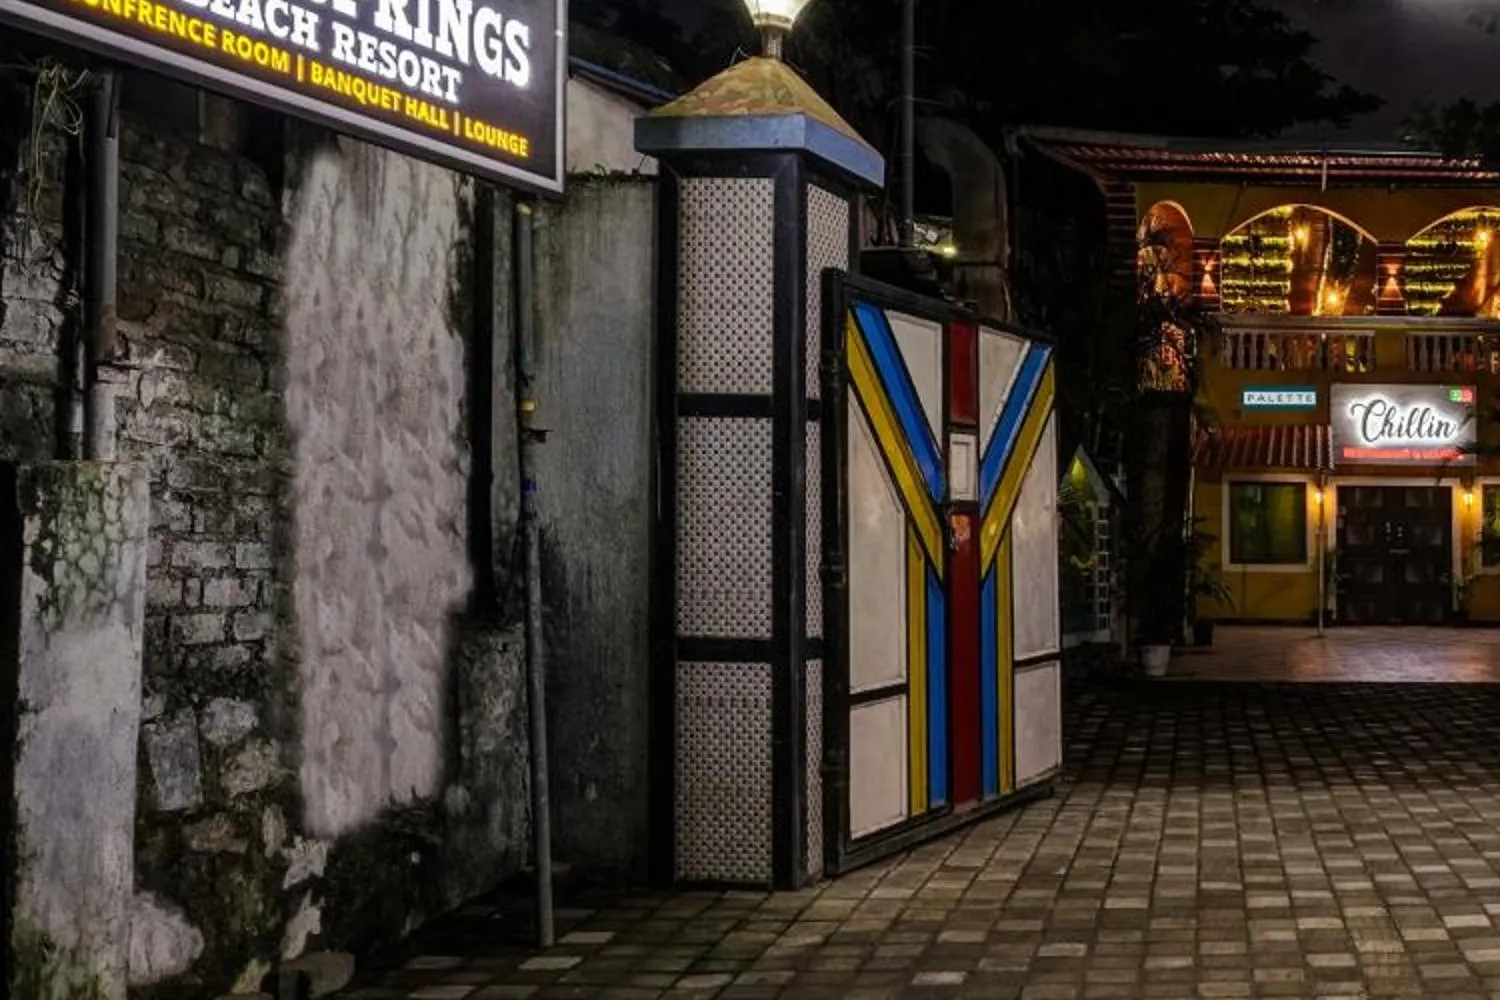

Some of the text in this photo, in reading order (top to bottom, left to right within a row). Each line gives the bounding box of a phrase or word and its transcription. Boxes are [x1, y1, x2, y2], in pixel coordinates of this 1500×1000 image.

[331, 21, 463, 104] RESORT
[222, 31, 290, 75] ROOM
[310, 60, 401, 111] BANQUET
[404, 97, 450, 131] HALL
[464, 118, 530, 158] LOUNGE
[1246, 392, 1314, 404] PALETTE
[1351, 398, 1457, 442] Chillin
